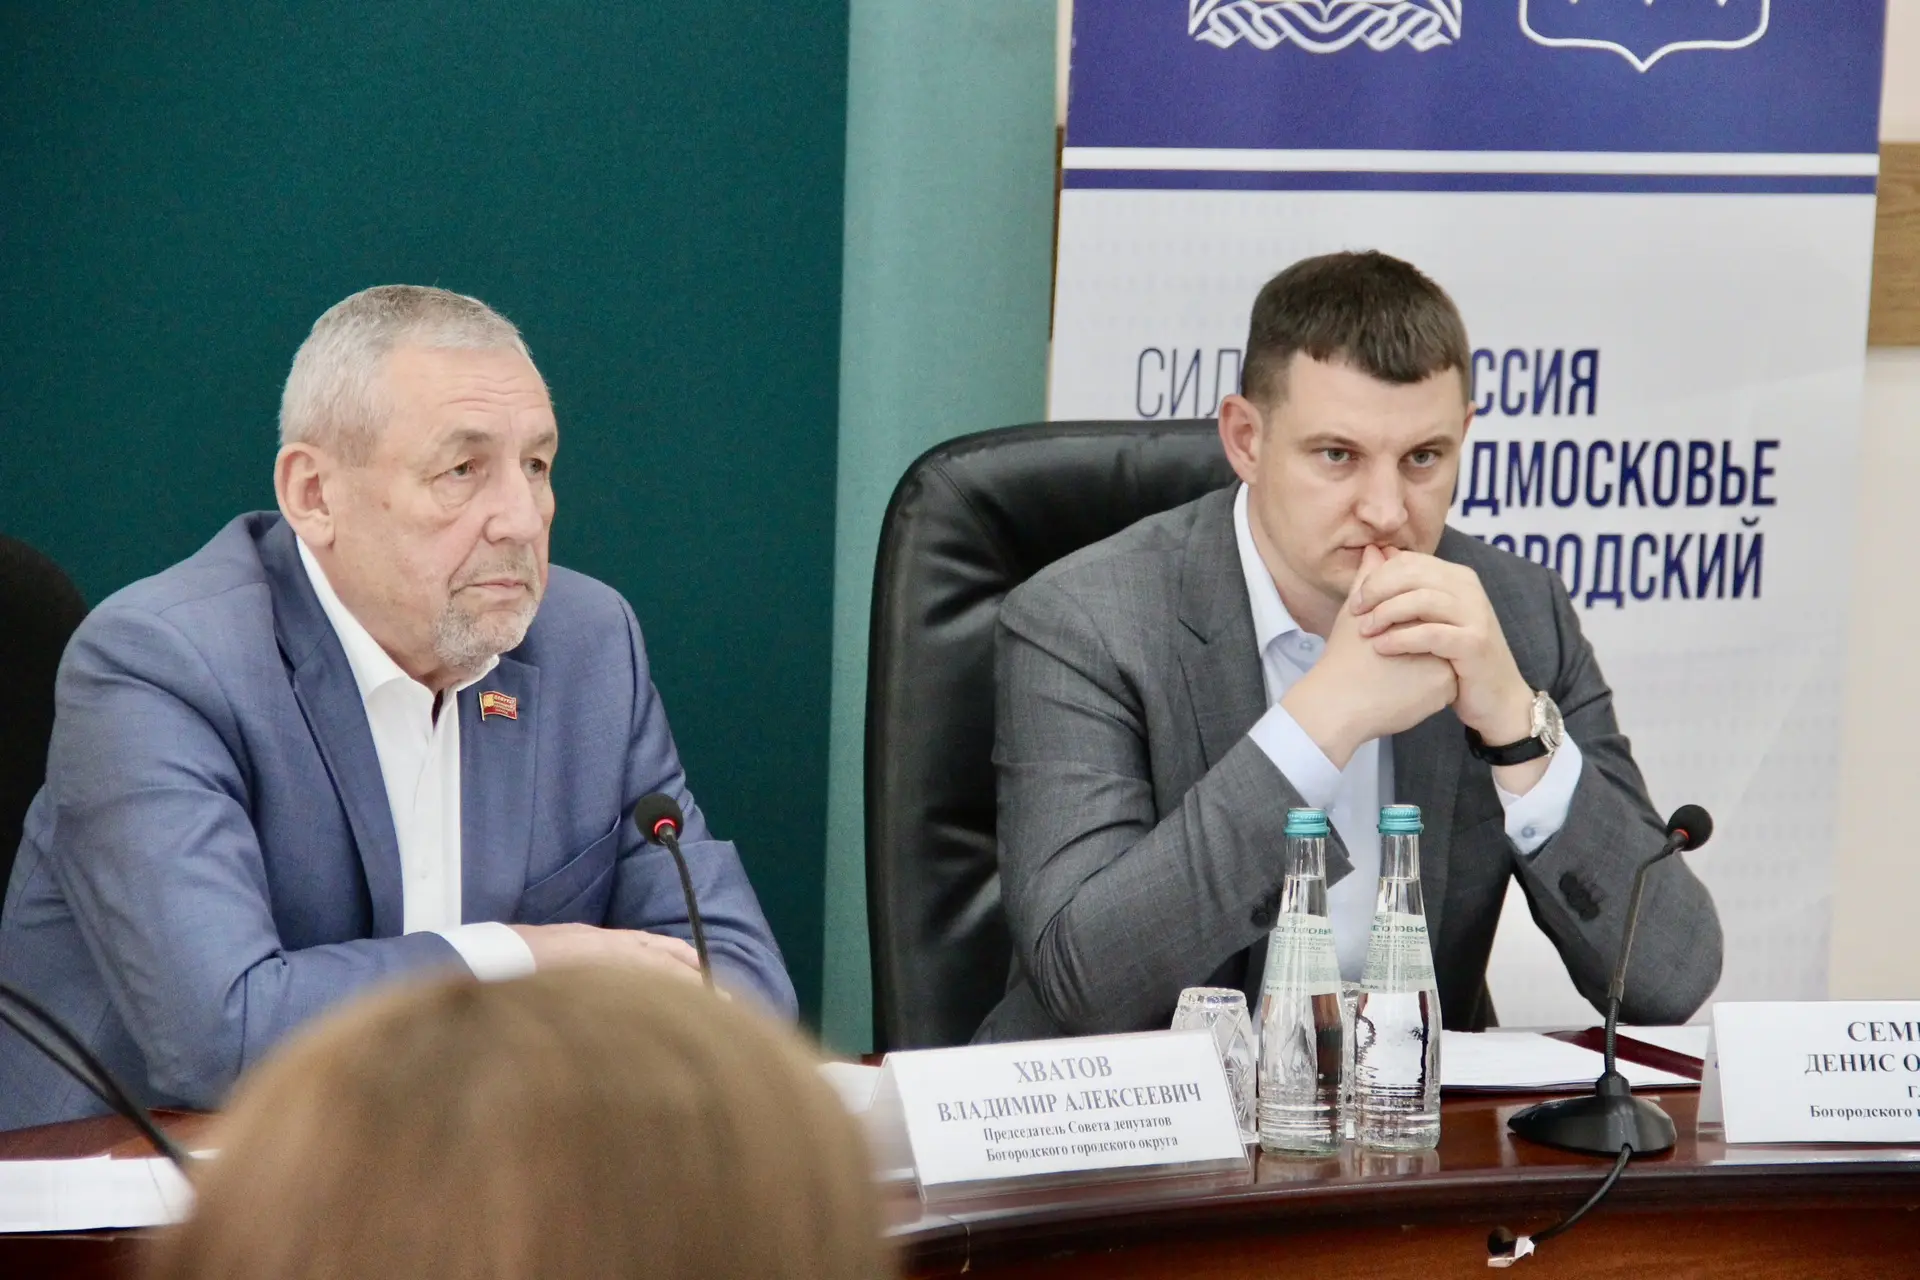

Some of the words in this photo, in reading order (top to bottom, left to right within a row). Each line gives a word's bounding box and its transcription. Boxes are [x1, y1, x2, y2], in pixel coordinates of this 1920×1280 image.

[1136, 347, 1242, 418] СИЛ
[1471, 348, 1600, 416] ССИЯ
[1451, 439, 1780, 517] ДМОСКОВЬЕ
[1013, 1055, 1113, 1084] ХВАТОВ
[1804, 1053, 1895, 1075] ДЕНИС
[937, 1093, 1057, 1122] ВЛАДИМИР
[1065, 1082, 1203, 1112] АЛЕКСЕЕВИЧ
[1908, 1085, 1920, 1098] Г
[1810, 1104, 1912, 1120] Богородского
[983, 1125, 1067, 1144] Председатель
[1068, 1120, 1111, 1134] Совета
[1113, 1116, 1172, 1132] депутатов
[986, 1144, 1069, 1163] Богородского
[1071, 1139, 1136, 1157] городского
[1138, 1136, 1179, 1151] округа
